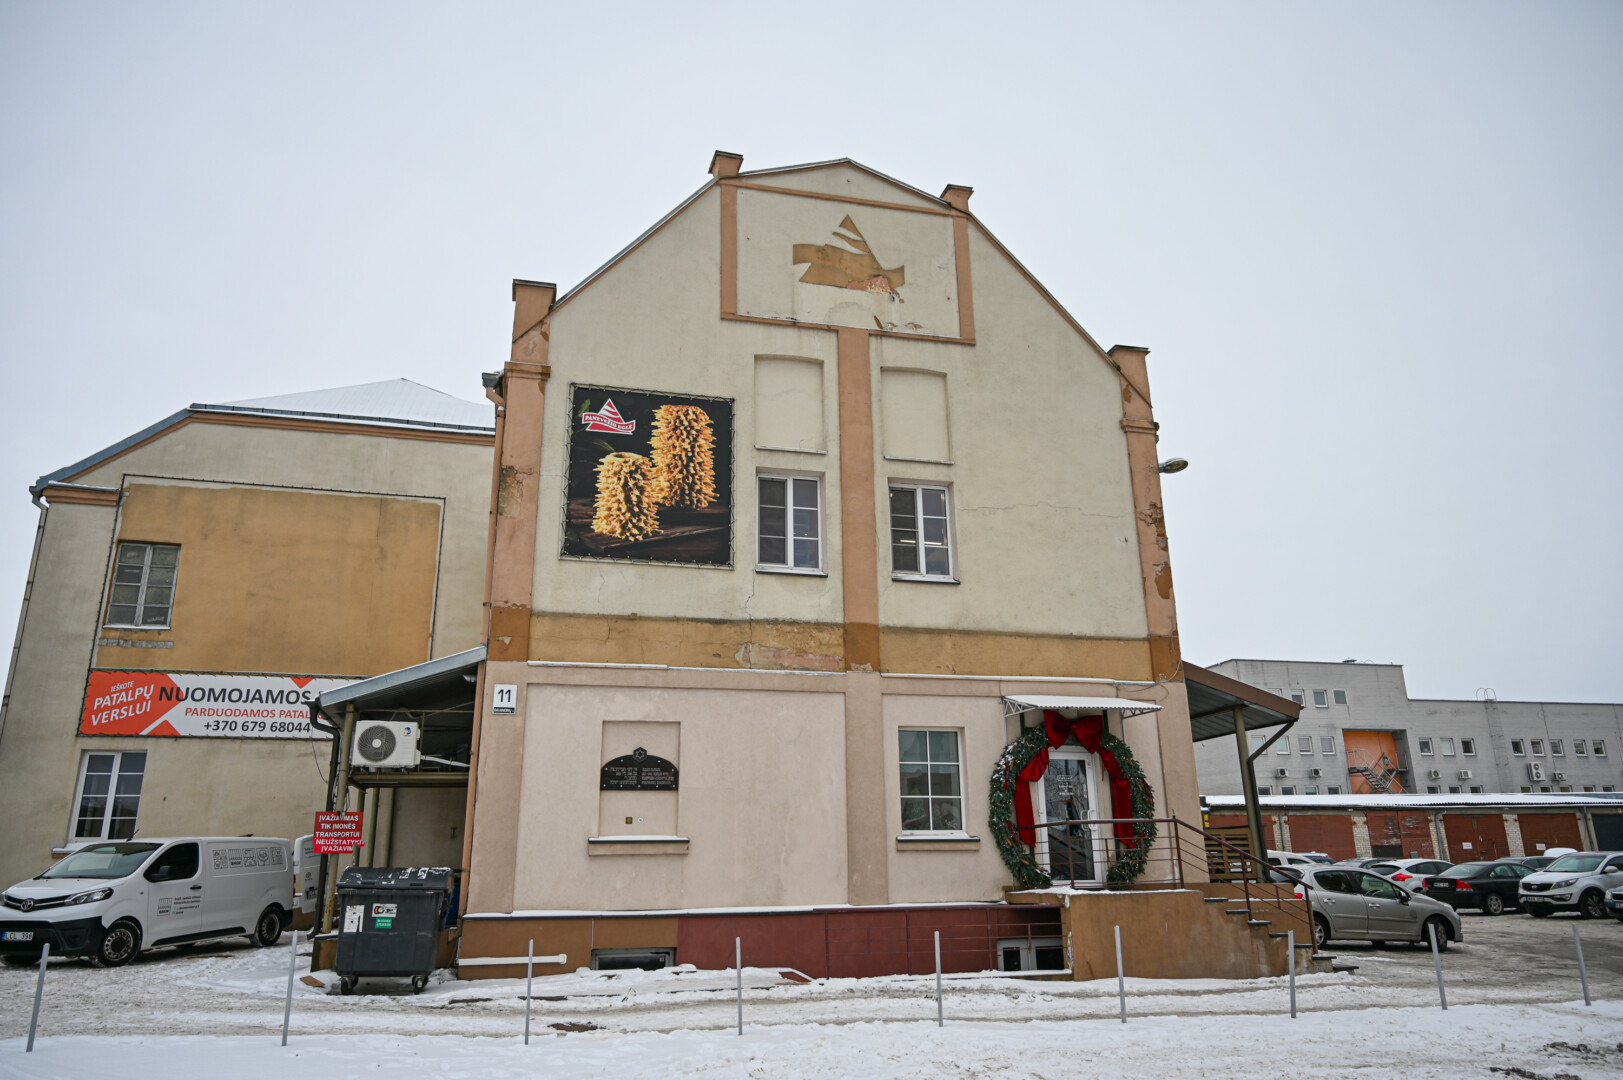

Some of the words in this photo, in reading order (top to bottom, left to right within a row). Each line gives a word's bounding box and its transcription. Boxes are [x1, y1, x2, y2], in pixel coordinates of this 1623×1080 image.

[111, 681, 135, 692] IEŠKOTE
[93, 684, 155, 710] PATALPŲ
[158, 686, 311, 705] NUOMOJAMOS
[498, 688, 511, 703] 11
[91, 700, 152, 726] VERSLUI
[184, 707, 276, 719] PARDUODAMOS
[204, 720, 238, 732] +370
[241, 721, 266, 732] 679
[270, 721, 311, 733] 68044
